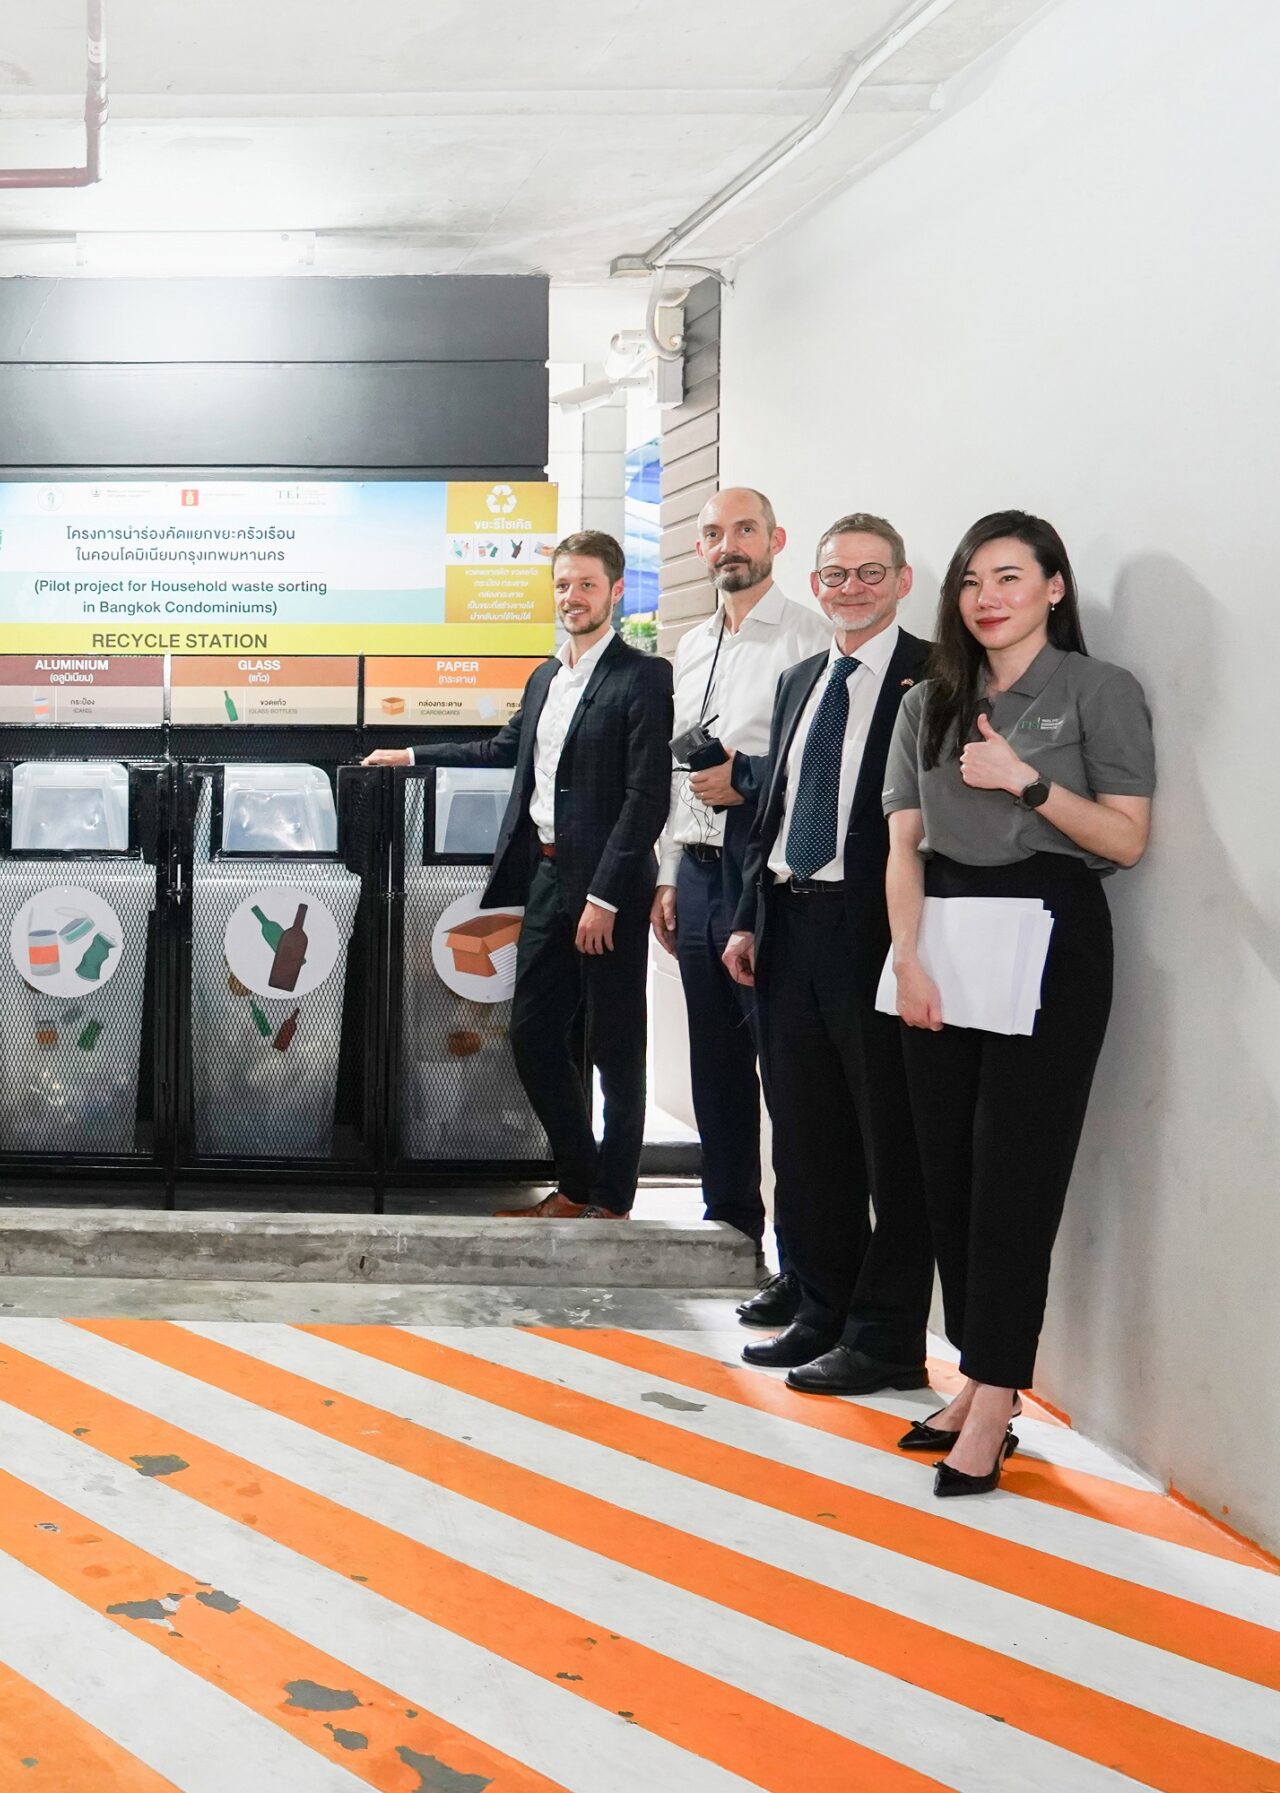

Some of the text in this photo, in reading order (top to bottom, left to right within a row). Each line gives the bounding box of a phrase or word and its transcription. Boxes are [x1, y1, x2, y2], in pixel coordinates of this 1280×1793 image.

[66, 525, 296, 540] โครงการนำร่องคัดแยกขยะครัวเรือน
[76, 546, 286, 566] ในคอนโดมิเนียมกรุงเทพมหานคร
[34, 579, 327, 596] (Pilot project for Household waste sorting
[83, 600, 278, 617] in Bangkok Condominiums)
[92, 633, 268, 649] RECYCLE STATION
[34, 659, 110, 671] ALUMINIUM
[237, 659, 281, 672] GLASS
[436, 660, 480, 672] PAPER
[248, 672, 270, 684] (แก้ว)
